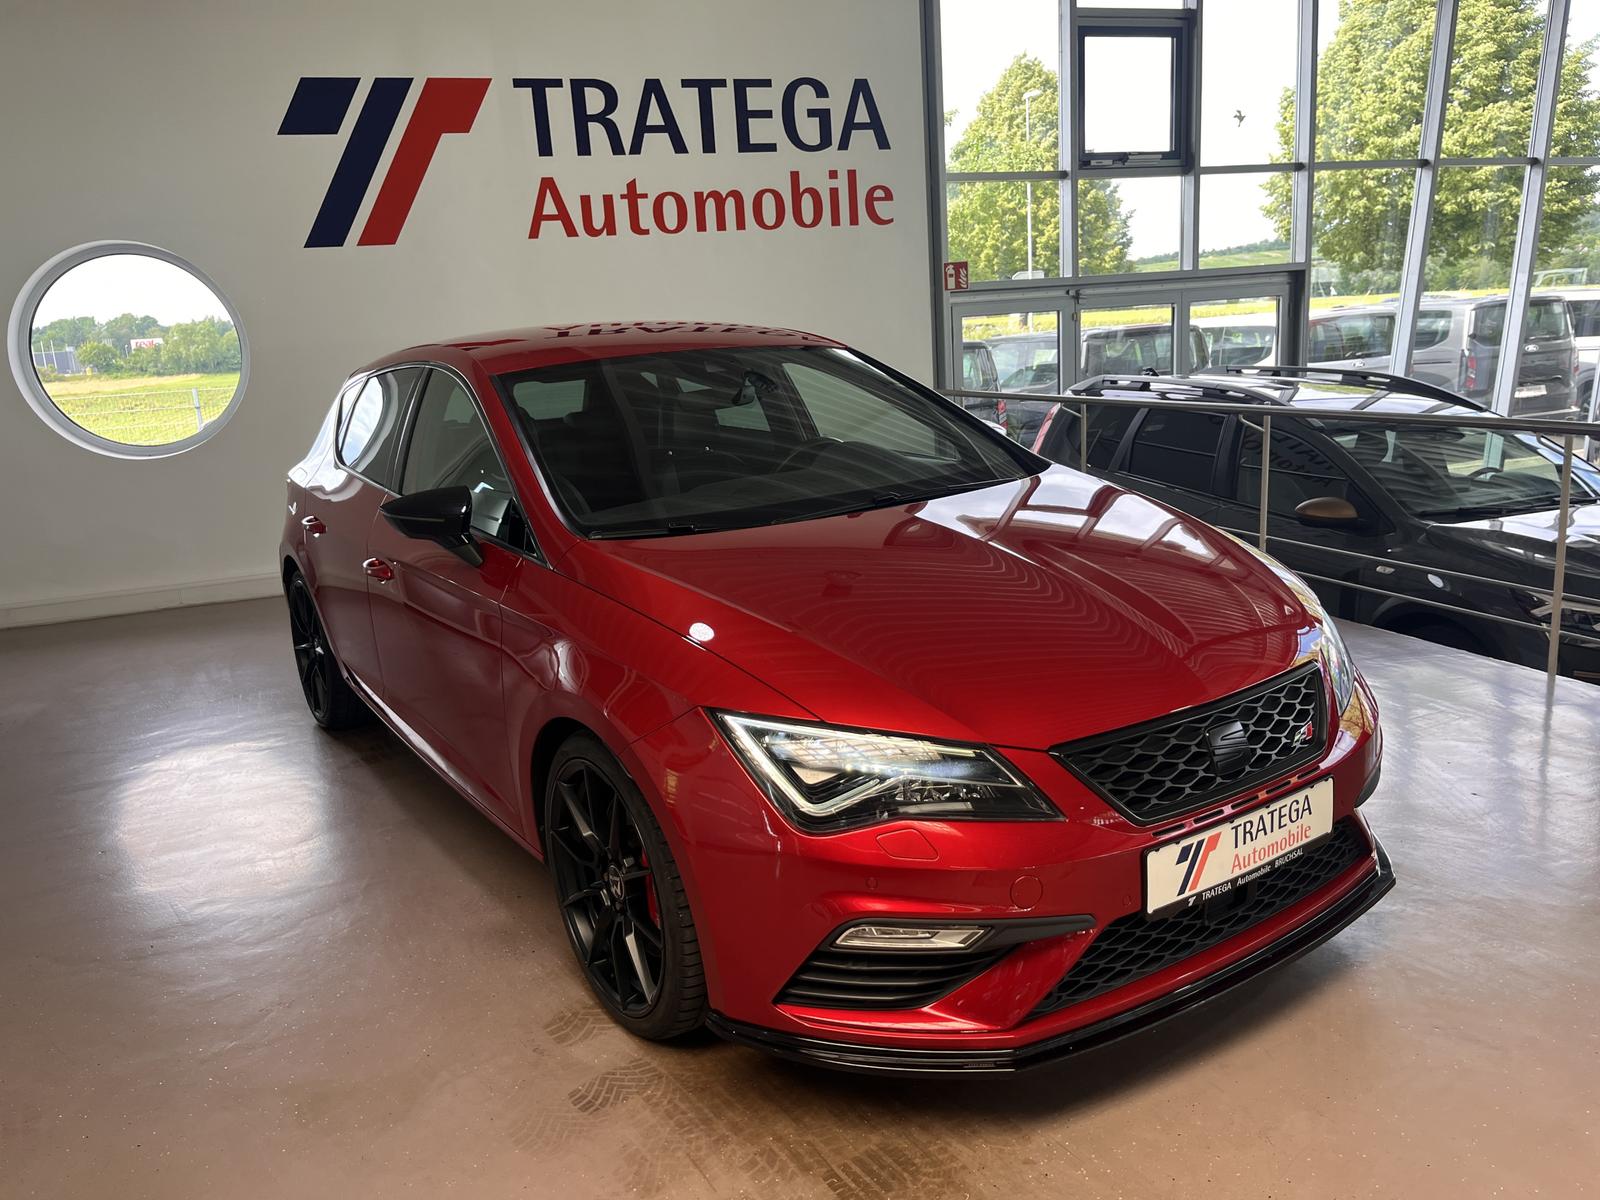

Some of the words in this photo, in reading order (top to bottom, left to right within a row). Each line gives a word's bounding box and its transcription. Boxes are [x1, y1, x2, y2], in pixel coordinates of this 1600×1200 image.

[512, 76, 892, 158] TRATEGA
[527, 169, 895, 240] Automobile
[1231, 794, 1313, 849] TRATEGA
[1231, 823, 1312, 875] Automobile
[1201, 882, 1232, 901] TRATEGA
[1236, 864, 1272, 887] Automobile
[1274, 847, 1304, 869] BRUCHSAL
